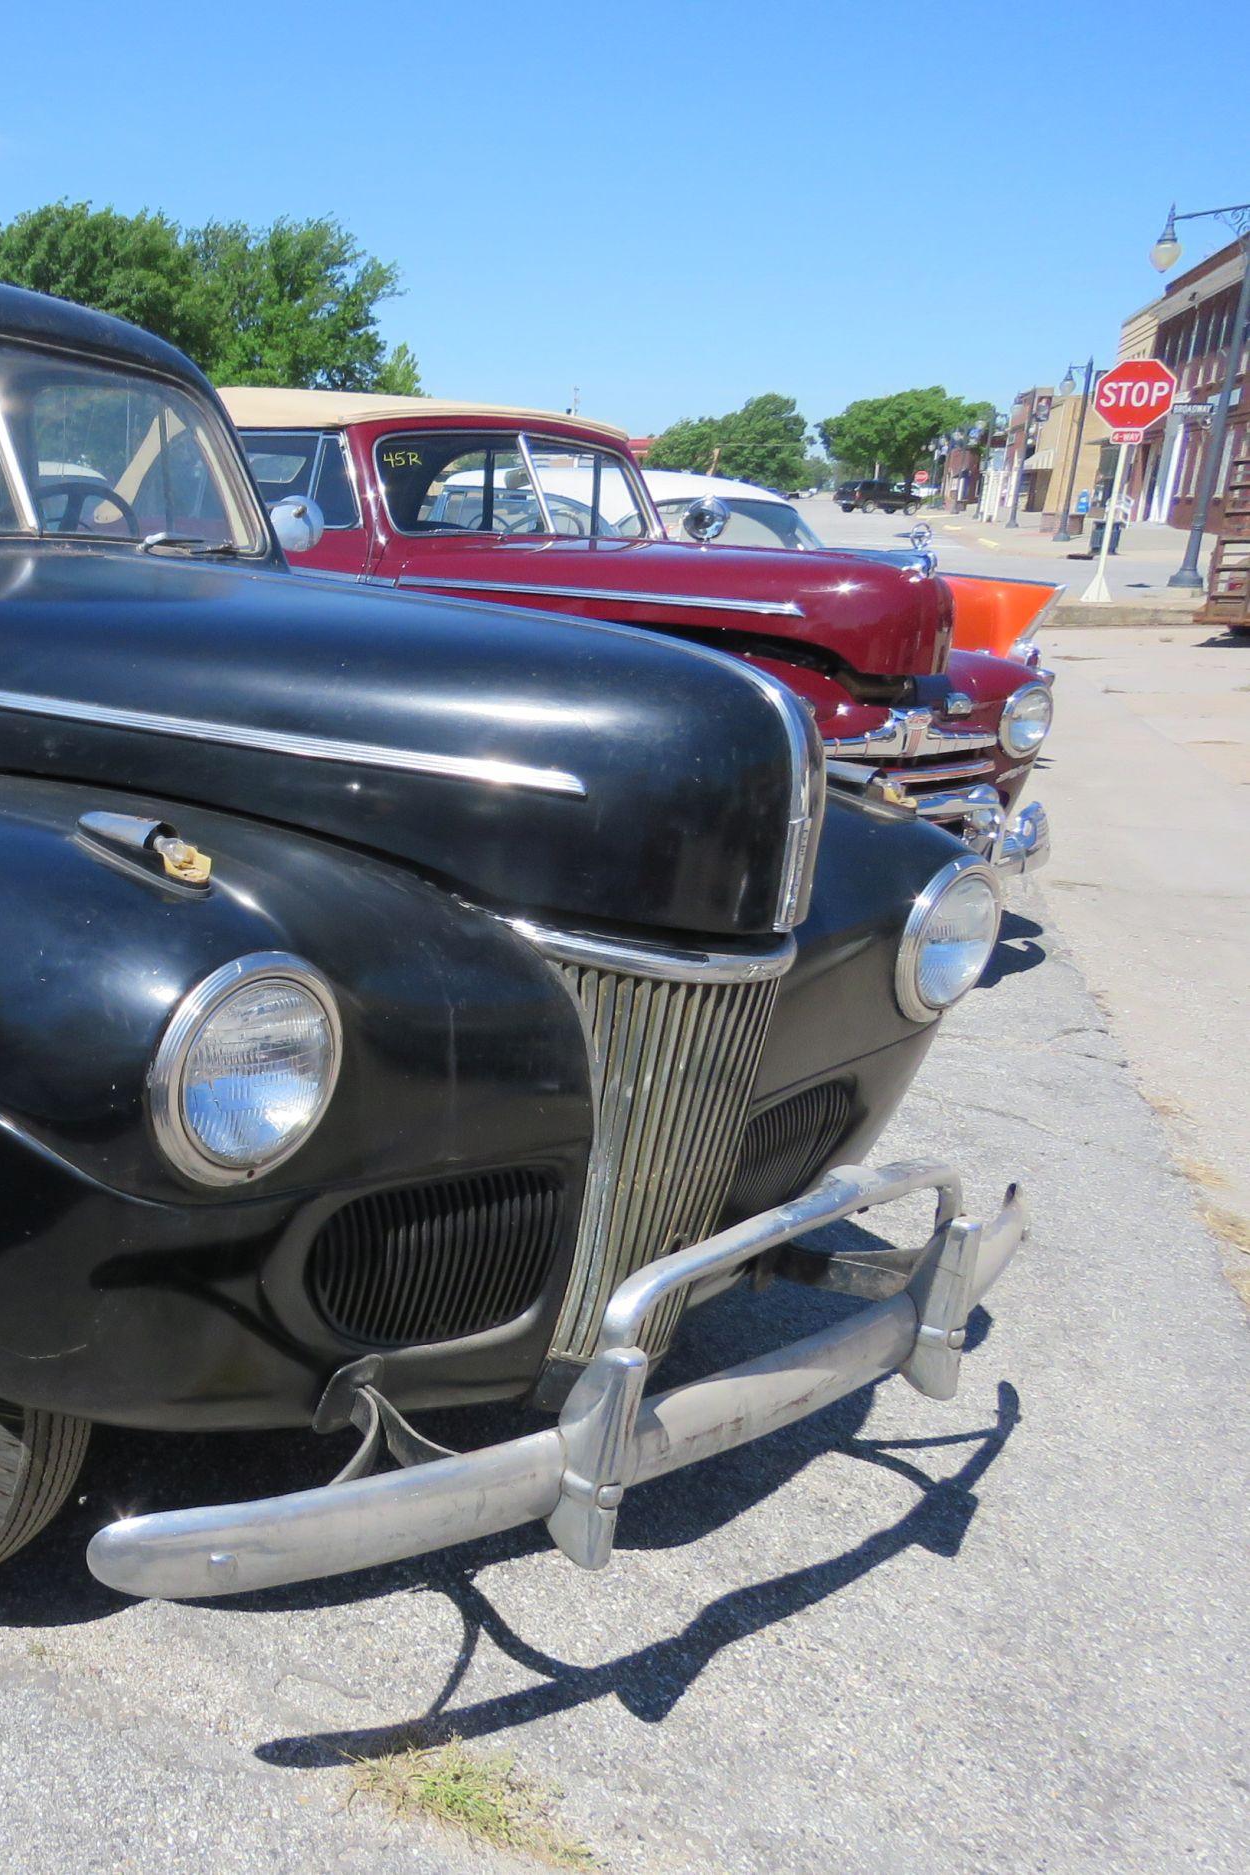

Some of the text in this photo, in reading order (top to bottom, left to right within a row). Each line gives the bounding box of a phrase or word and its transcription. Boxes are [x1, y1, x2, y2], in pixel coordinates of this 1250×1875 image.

[1099, 381, 1170, 407] STOP
[1112, 432, 1141, 442] 4-WAY
[383, 451, 422, 468] 45R
